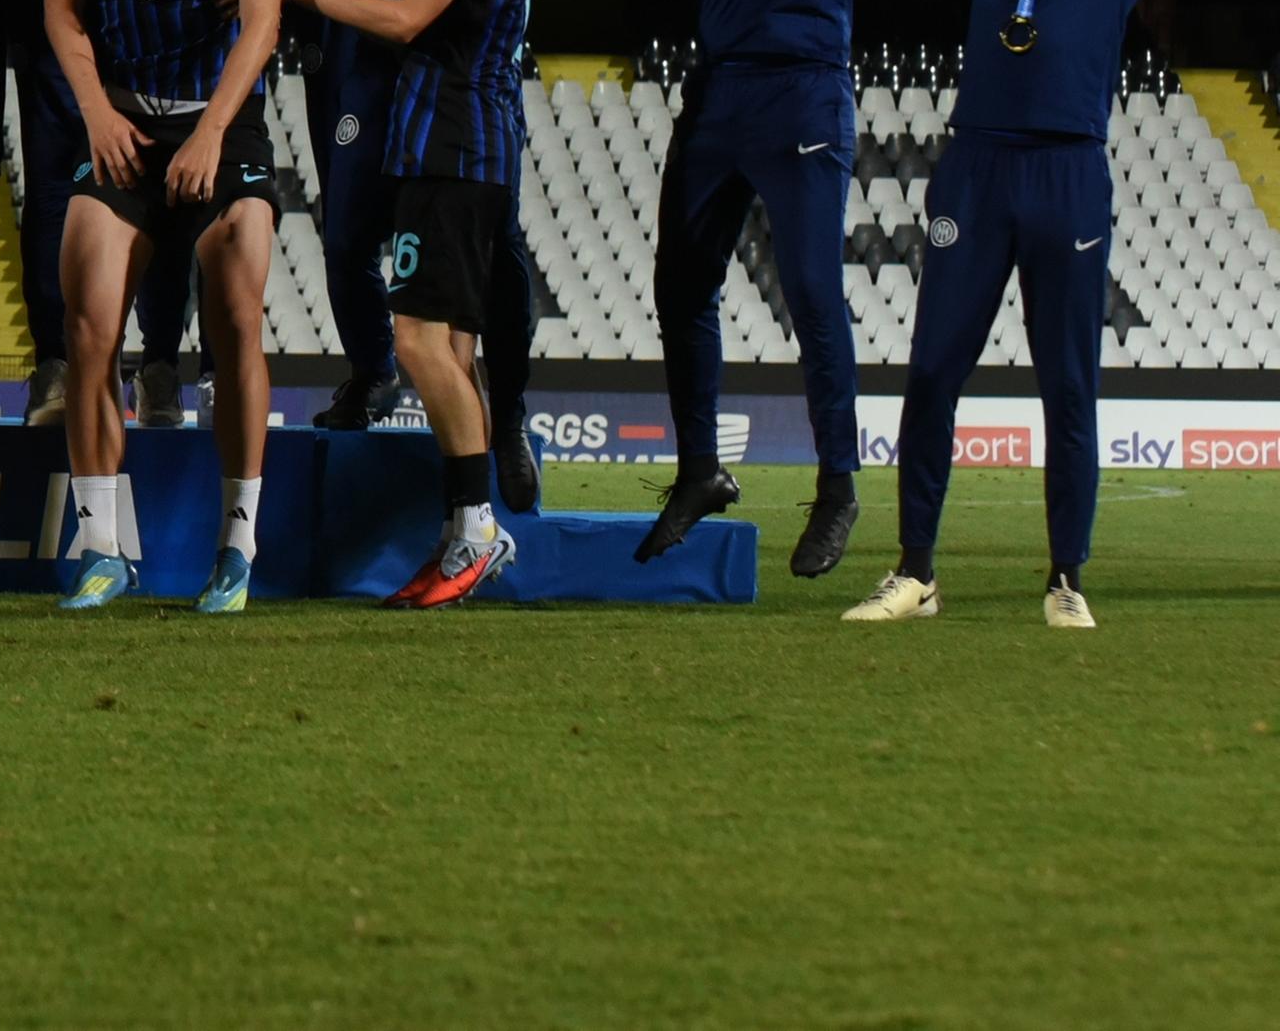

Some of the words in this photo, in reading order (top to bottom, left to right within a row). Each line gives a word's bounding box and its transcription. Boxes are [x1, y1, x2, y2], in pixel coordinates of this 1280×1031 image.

[393, 231, 422, 279] 6
[529, 412, 608, 449] SGS
[860, 427, 900, 466] ky
[951, 433, 1023, 462] ort
[1110, 431, 1175, 468] sky
[1190, 438, 1280, 469] spor
